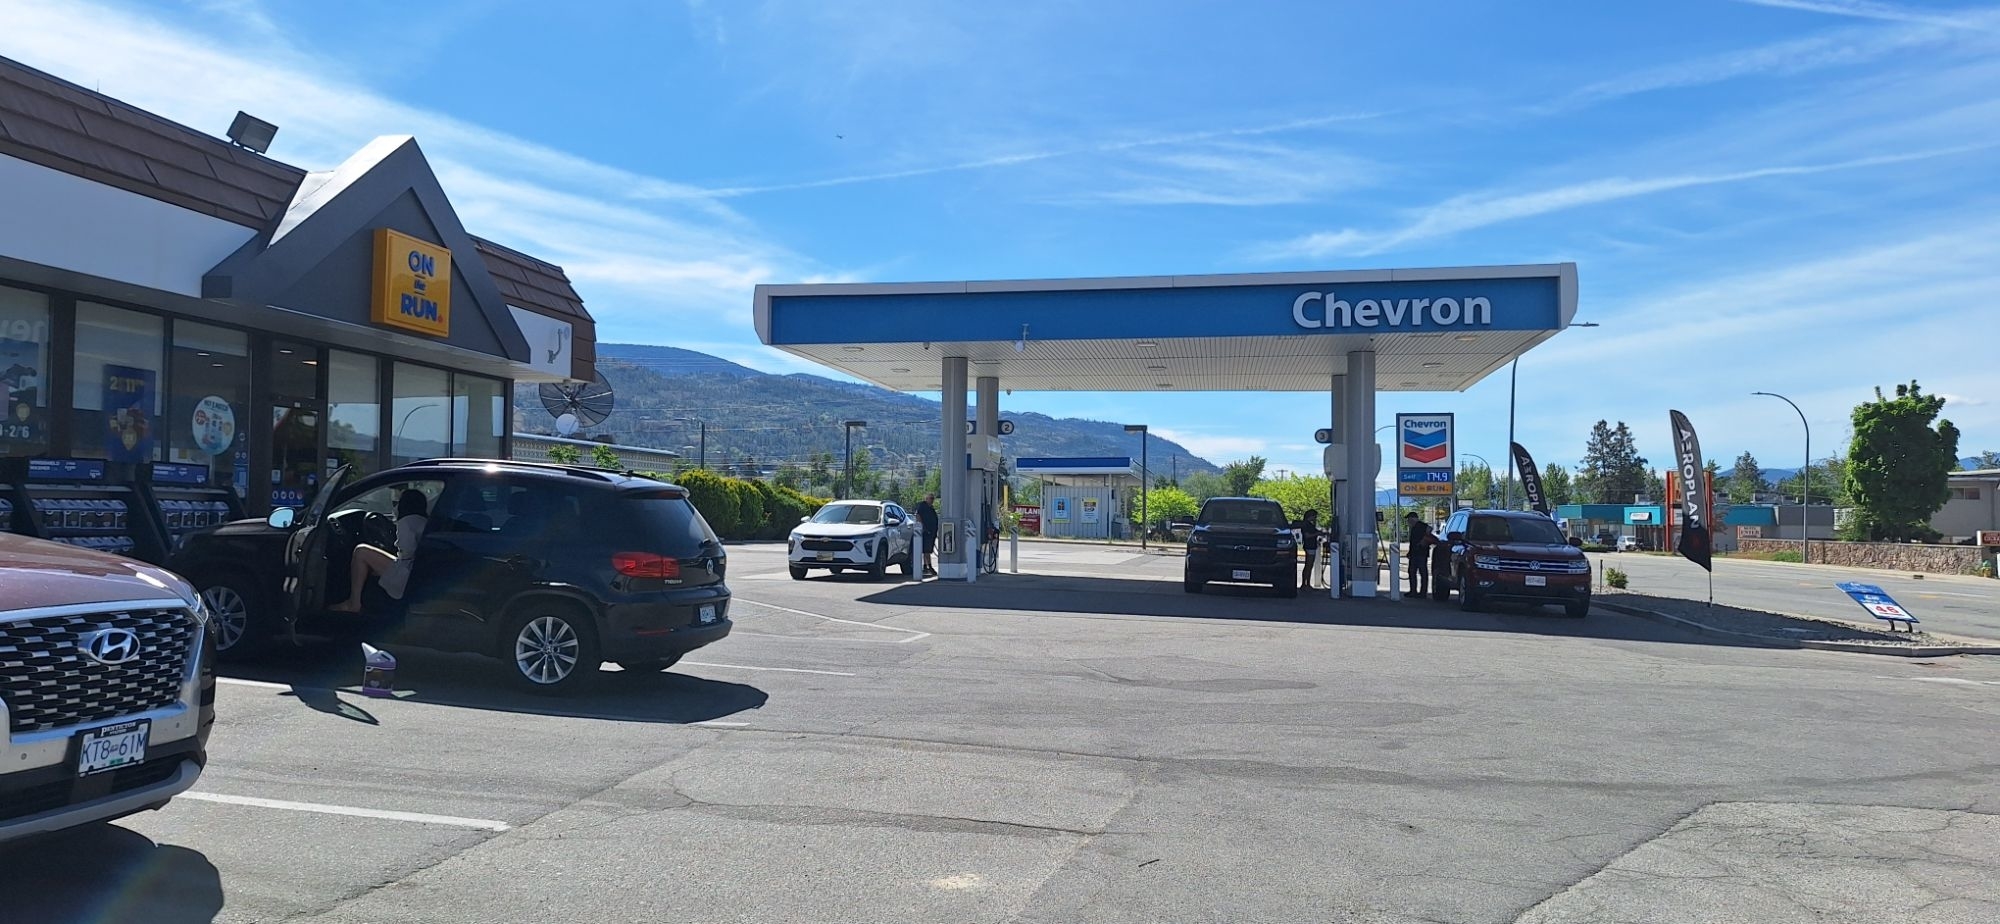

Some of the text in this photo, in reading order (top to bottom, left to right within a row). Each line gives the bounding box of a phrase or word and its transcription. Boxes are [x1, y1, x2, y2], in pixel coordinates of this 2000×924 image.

[408, 250, 435, 277] ON
[1292, 291, 1491, 328] Chevron
[1404, 419, 1447, 428] Chevron
[1427, 472, 1448, 481] 174.9
[1680, 428, 1700, 529] AEROPLAN
[1875, 605, 1900, 614] 46
